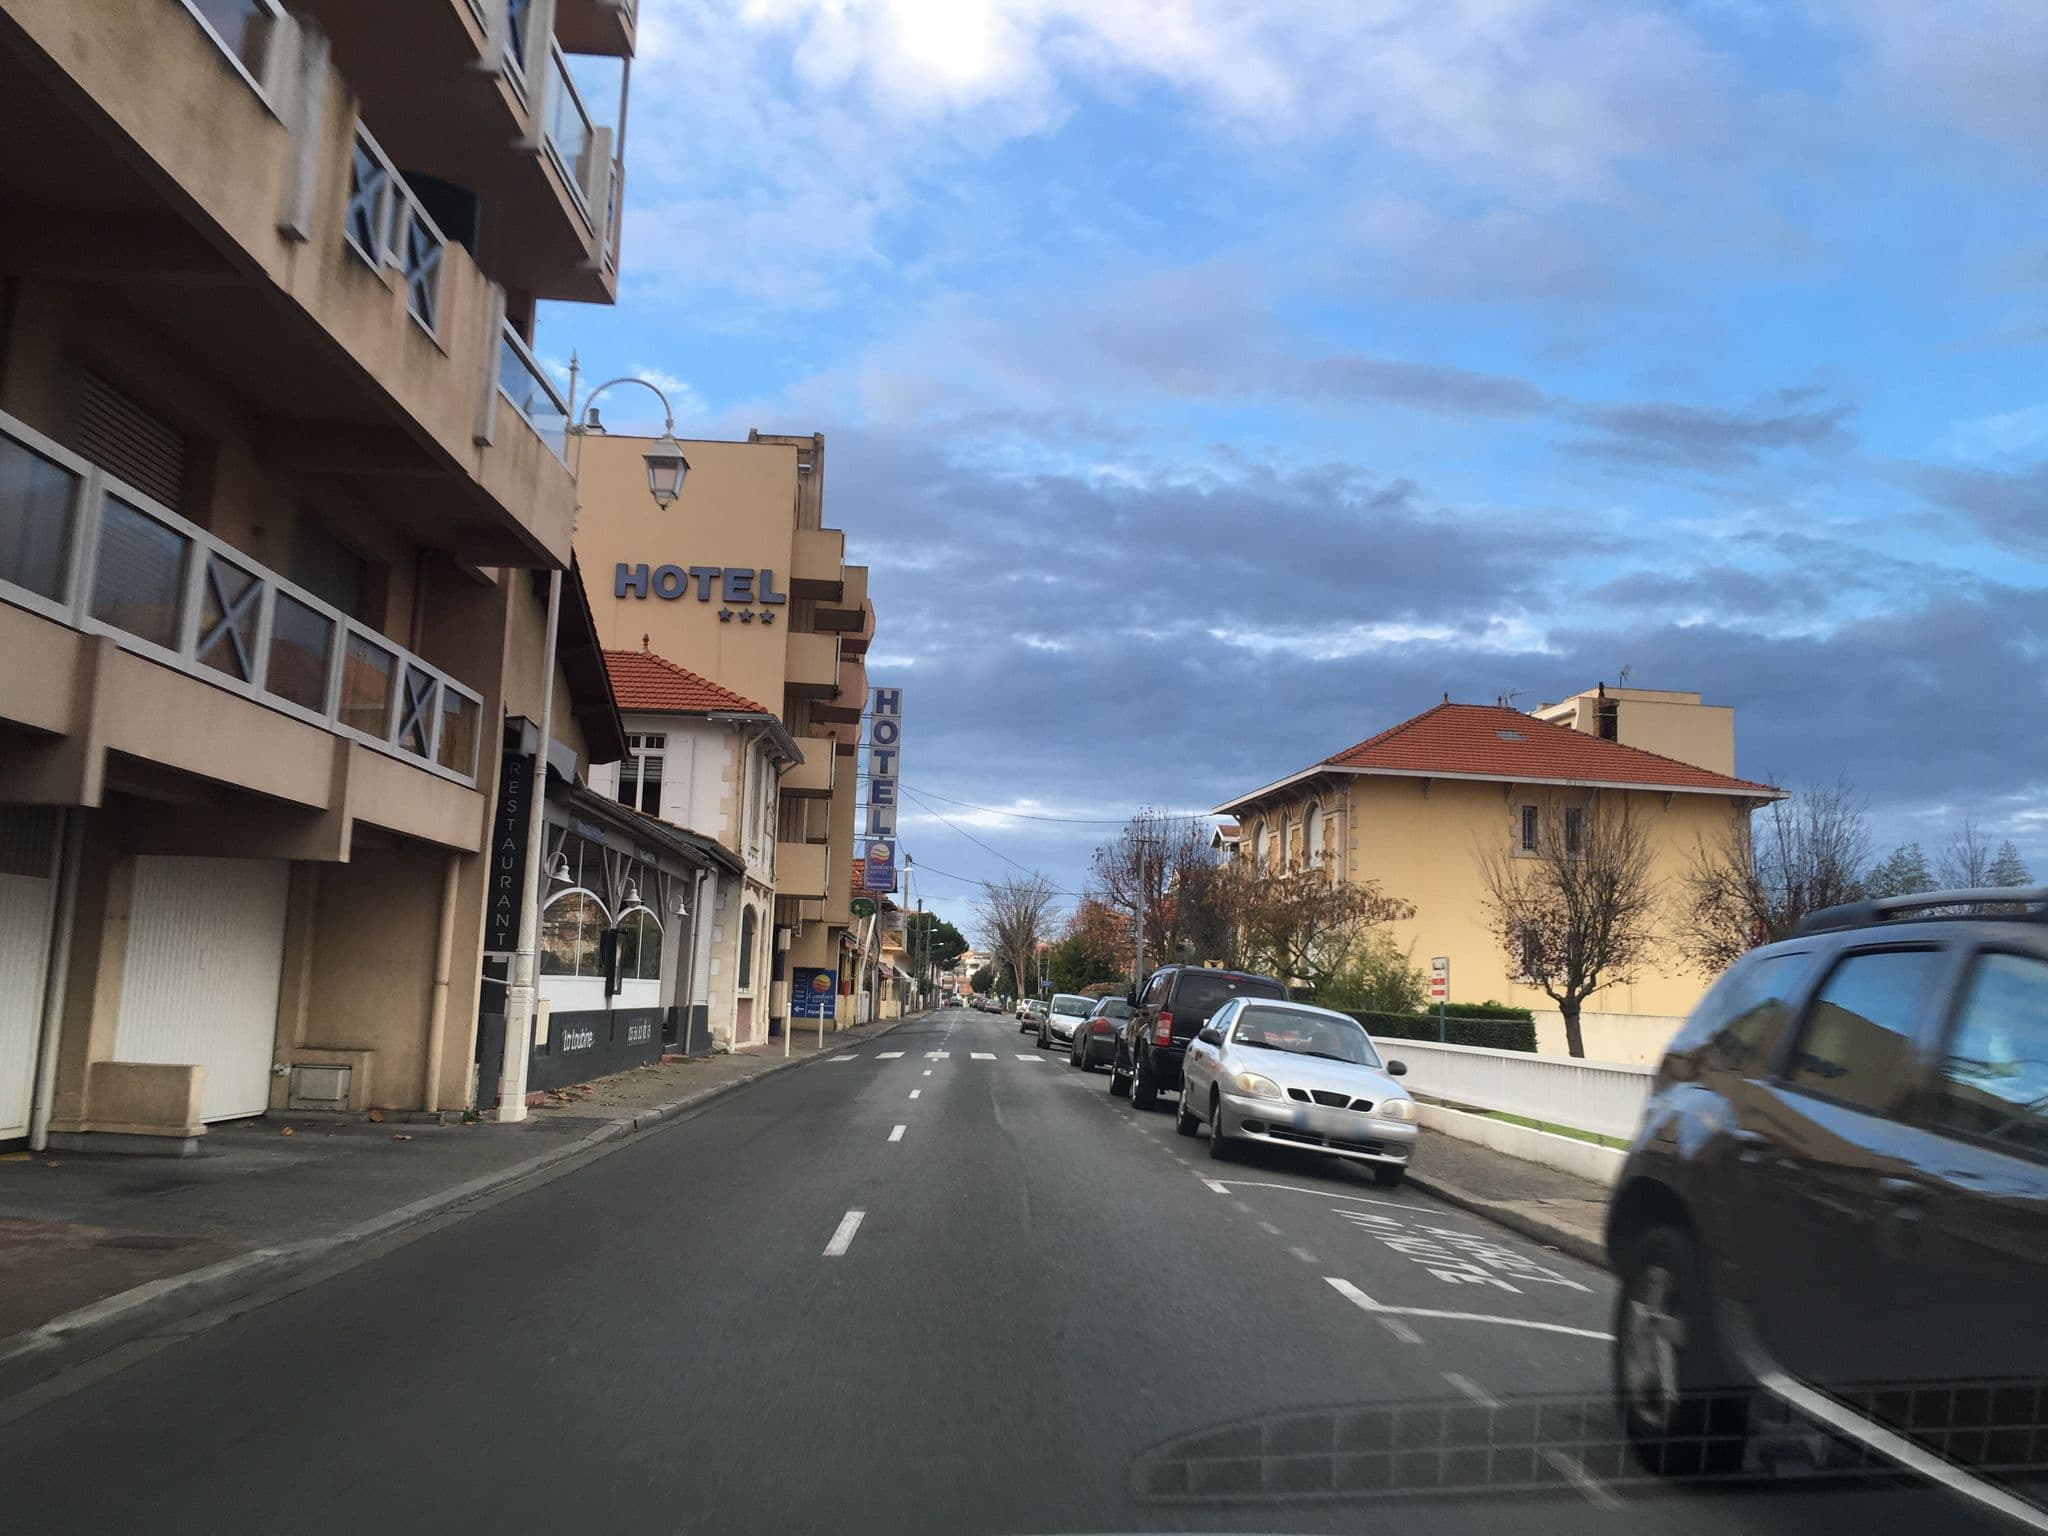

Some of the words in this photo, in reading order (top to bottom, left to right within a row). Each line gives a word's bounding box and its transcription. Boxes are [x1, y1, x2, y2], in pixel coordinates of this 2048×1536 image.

[614, 563, 786, 604] HOTEL
[872, 689, 900, 835] HOTEL
[496, 762, 520, 946] RESTAURANT
